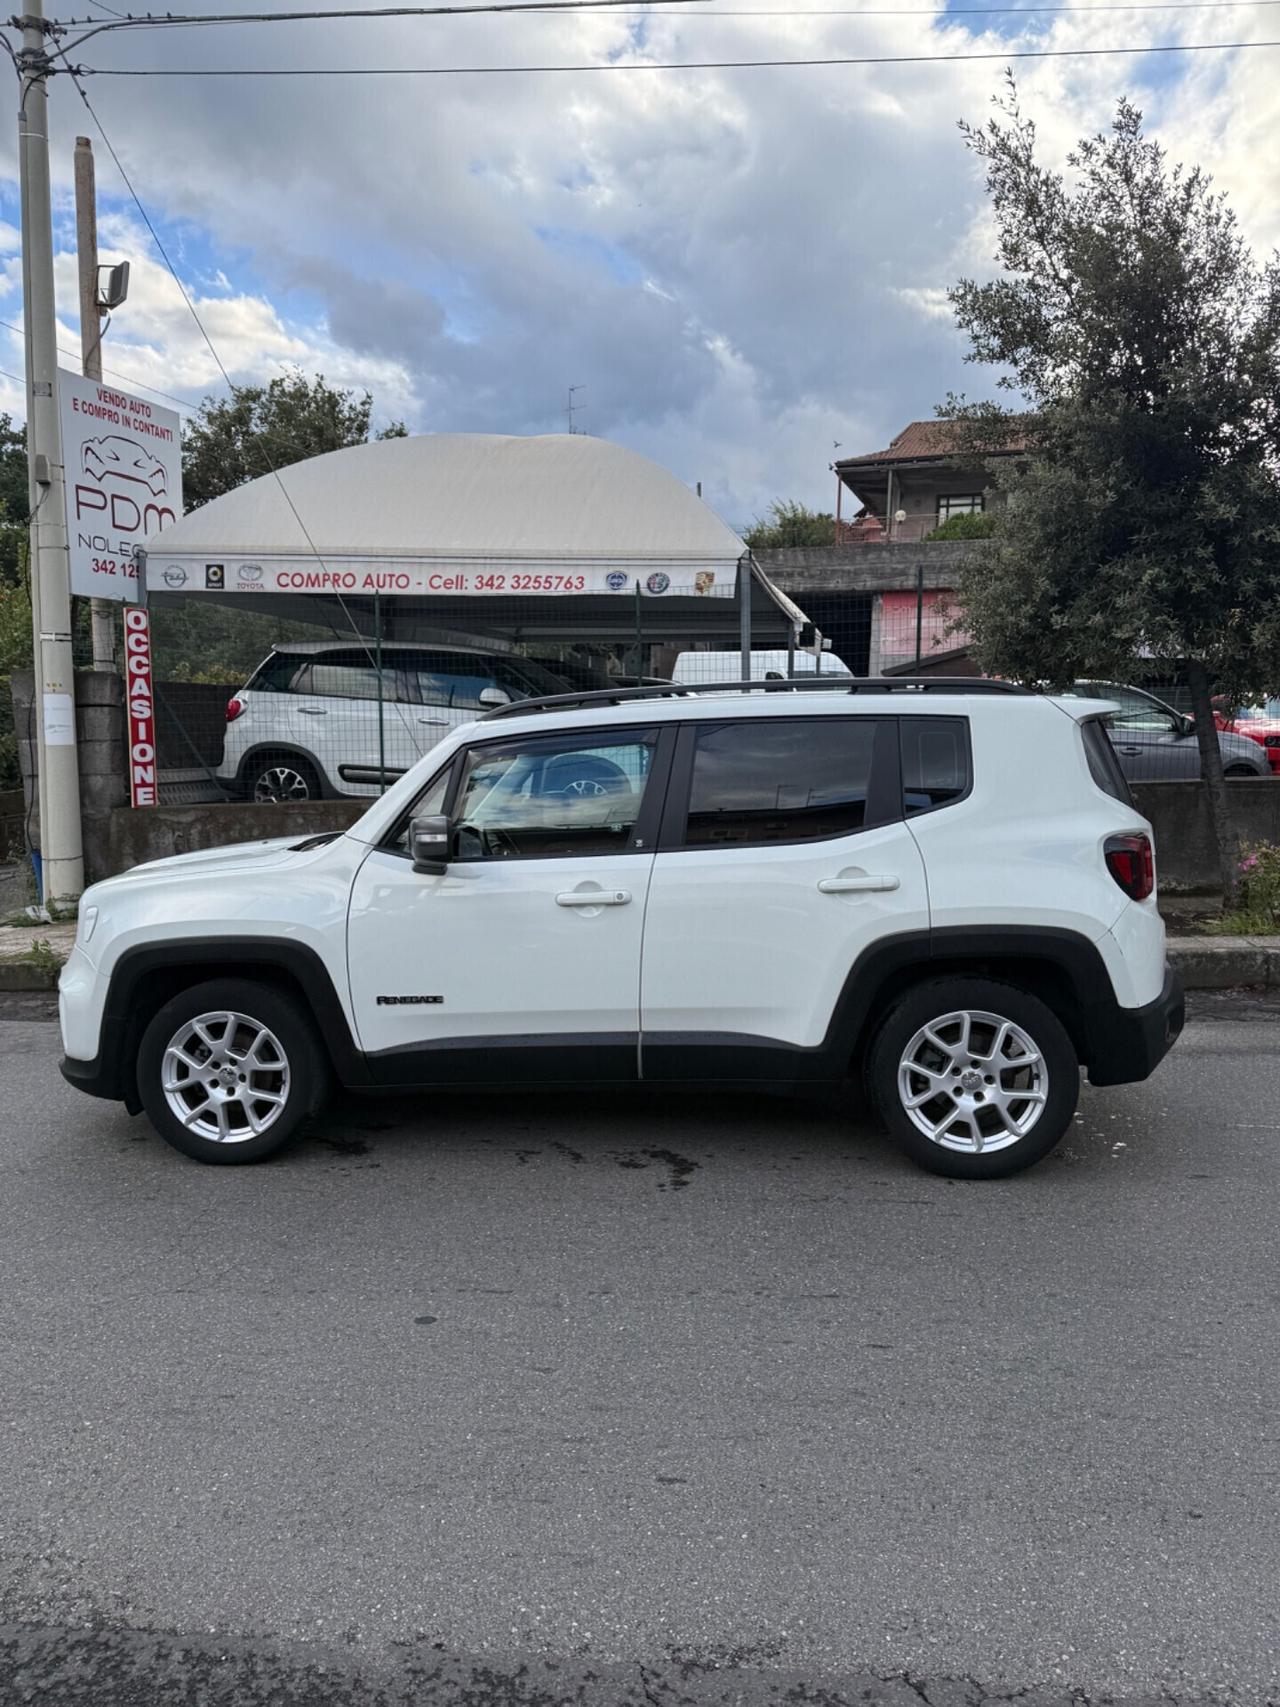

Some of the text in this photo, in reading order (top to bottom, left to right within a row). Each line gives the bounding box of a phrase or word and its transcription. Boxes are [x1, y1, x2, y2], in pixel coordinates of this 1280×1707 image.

[96, 387, 152, 418] VENDO AUTO
[72, 397, 173, 441] E COMPRO IN CONTANTI
[92, 558, 117, 577] 342
[237, 582, 265, 590] TOYOTA
[276, 572, 356, 589] COMPRO
[362, 572, 410, 590] AUTO
[428, 574, 469, 591] Cell:
[474, 574, 506, 591] 342
[510, 575, 585, 591] 3255763
[126, 610, 154, 806] OCCASIONE
[376, 995, 444, 1006] RENEGADE
